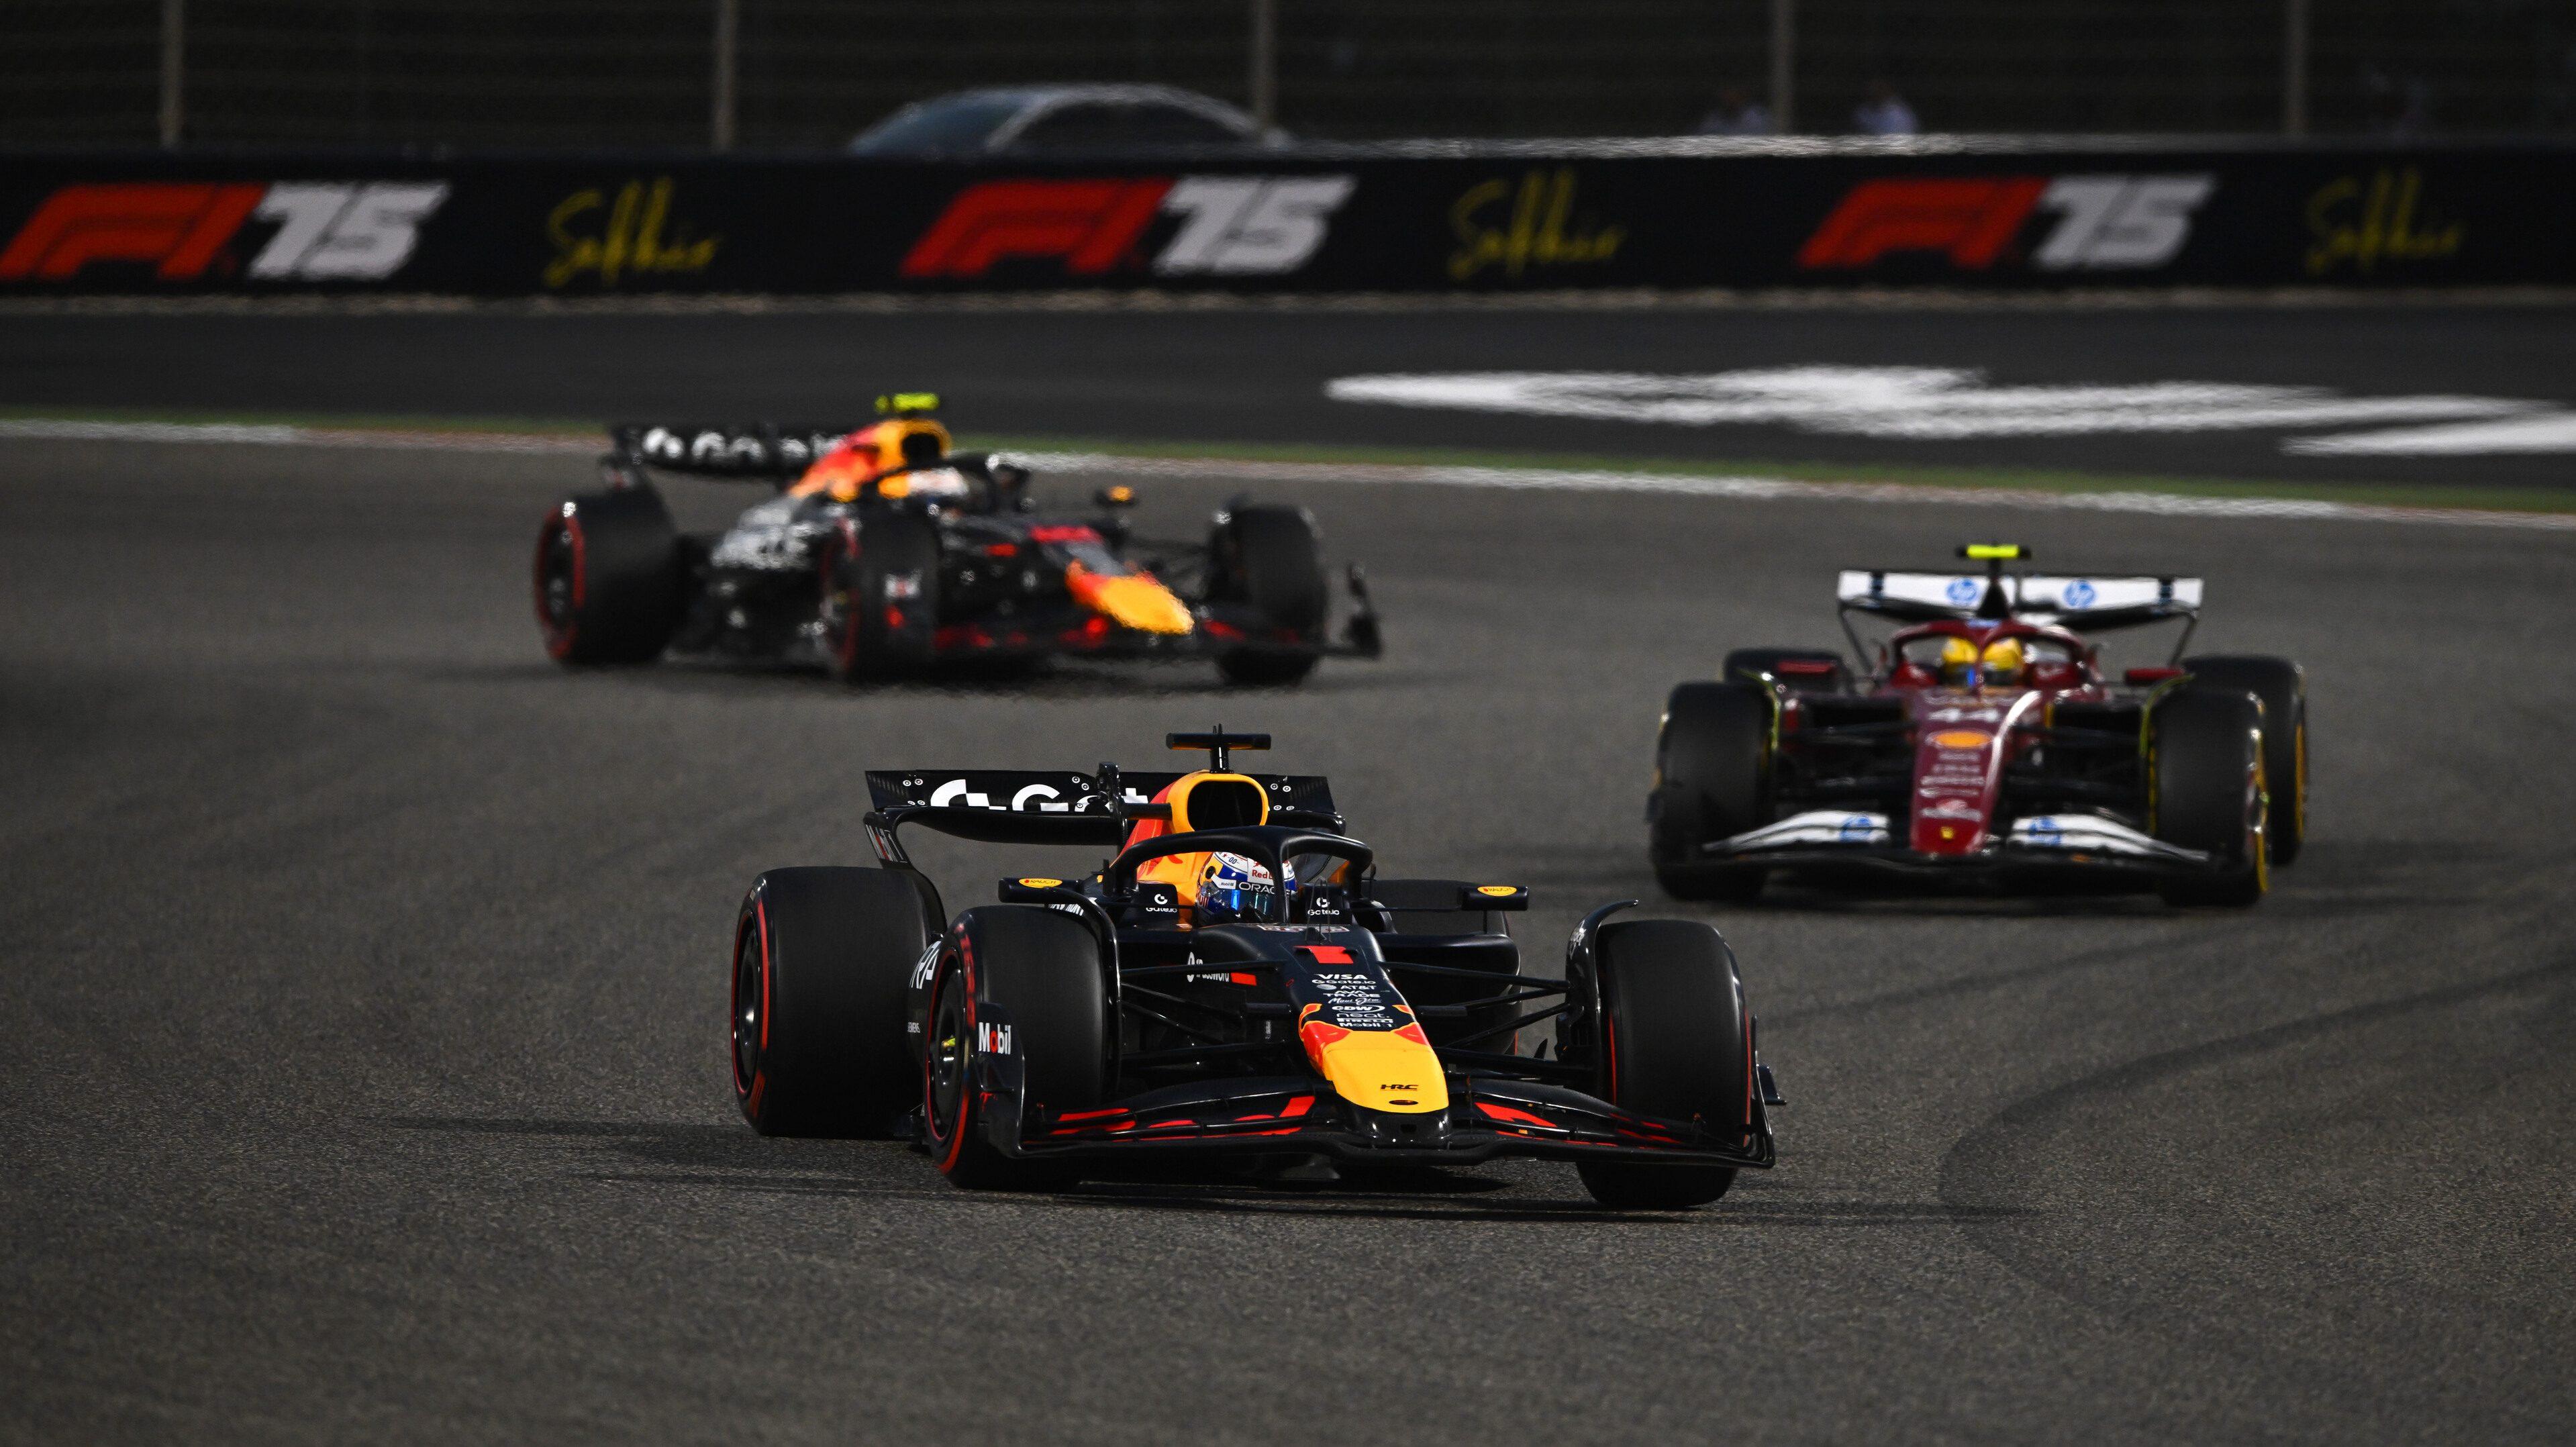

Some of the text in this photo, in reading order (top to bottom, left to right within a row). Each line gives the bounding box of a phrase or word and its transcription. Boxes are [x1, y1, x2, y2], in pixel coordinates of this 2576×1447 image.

[1252, 869, 1268, 879] Red
[1239, 882, 1275, 895] ORAC
[979, 1021, 1011, 1055] Mobil
